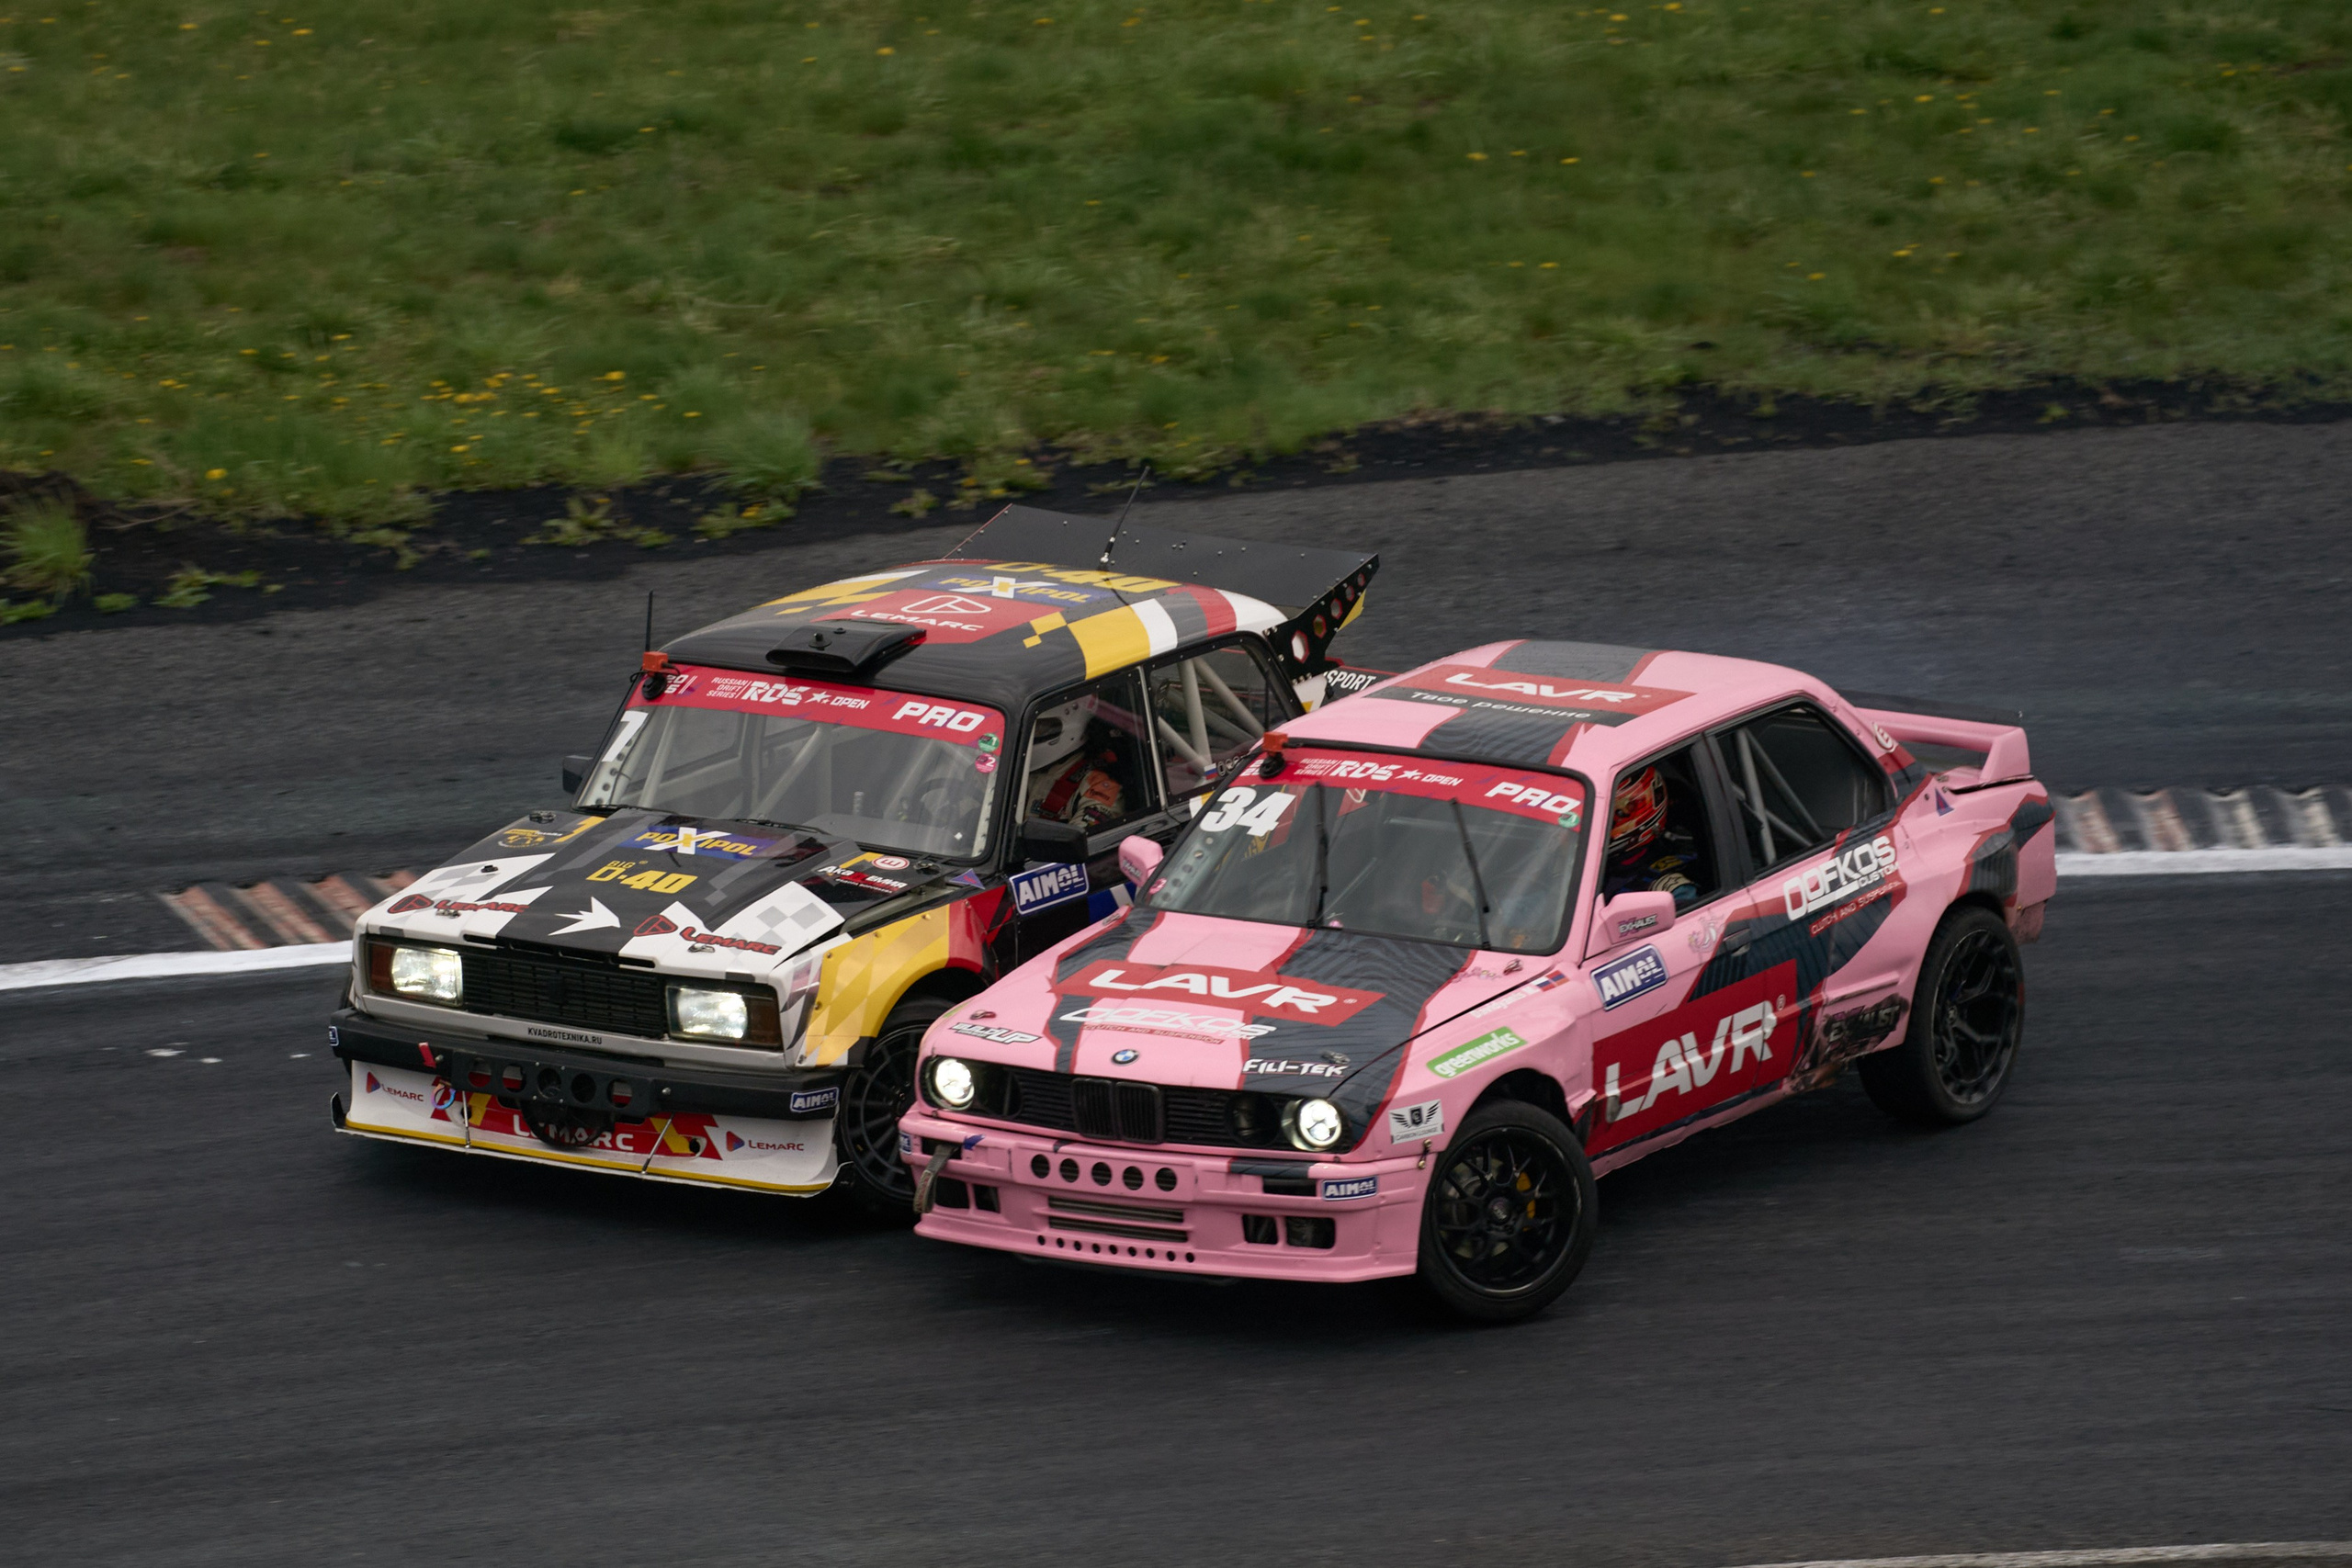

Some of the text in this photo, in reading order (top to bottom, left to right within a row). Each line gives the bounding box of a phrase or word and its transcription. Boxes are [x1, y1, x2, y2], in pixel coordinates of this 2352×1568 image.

[938, 576, 1094, 604] POXIPOL
[851, 609, 984, 632] LEMARC
[711, 677, 747, 686] RUSSIAN
[1324, 670, 1376, 691] SPORT
[1445, 672, 1636, 703] LAVR
[707, 690, 737, 698] SERIES
[741, 681, 871, 709] RDS OPEN
[1410, 691, 1591, 718] Твое решение
[891, 701, 985, 732] PRO
[1329, 761, 1464, 786] RDS OPEN
[1484, 781, 1581, 814] PRO
[1200, 786, 1296, 837] 34
[635, 827, 757, 855] POXIPOL
[606, 860, 636, 869] BIG
[1018, 863, 1085, 907] AIMOL
[434, 899, 529, 913] LEMARC
[1839, 903, 1857, 917] AND
[1619, 914, 1657, 933] EXHAUST
[680, 926, 782, 955] LEMARC
[1089, 969, 1338, 1013] LAVR
[1600, 955, 1664, 1002] AIMOL
[527, 1027, 602, 1044] KVADROTEXNIKA.RU
[1242, 1058, 1349, 1077] FILI-TEK
[1434, 1032, 1520, 1077] greenworks
[1605, 1000, 1777, 1123] LAVR
[381, 1083, 424, 1101] LEMARC
[749, 1140, 805, 1151] LEMARC
[1326, 1179, 1375, 1196] AIMOL
